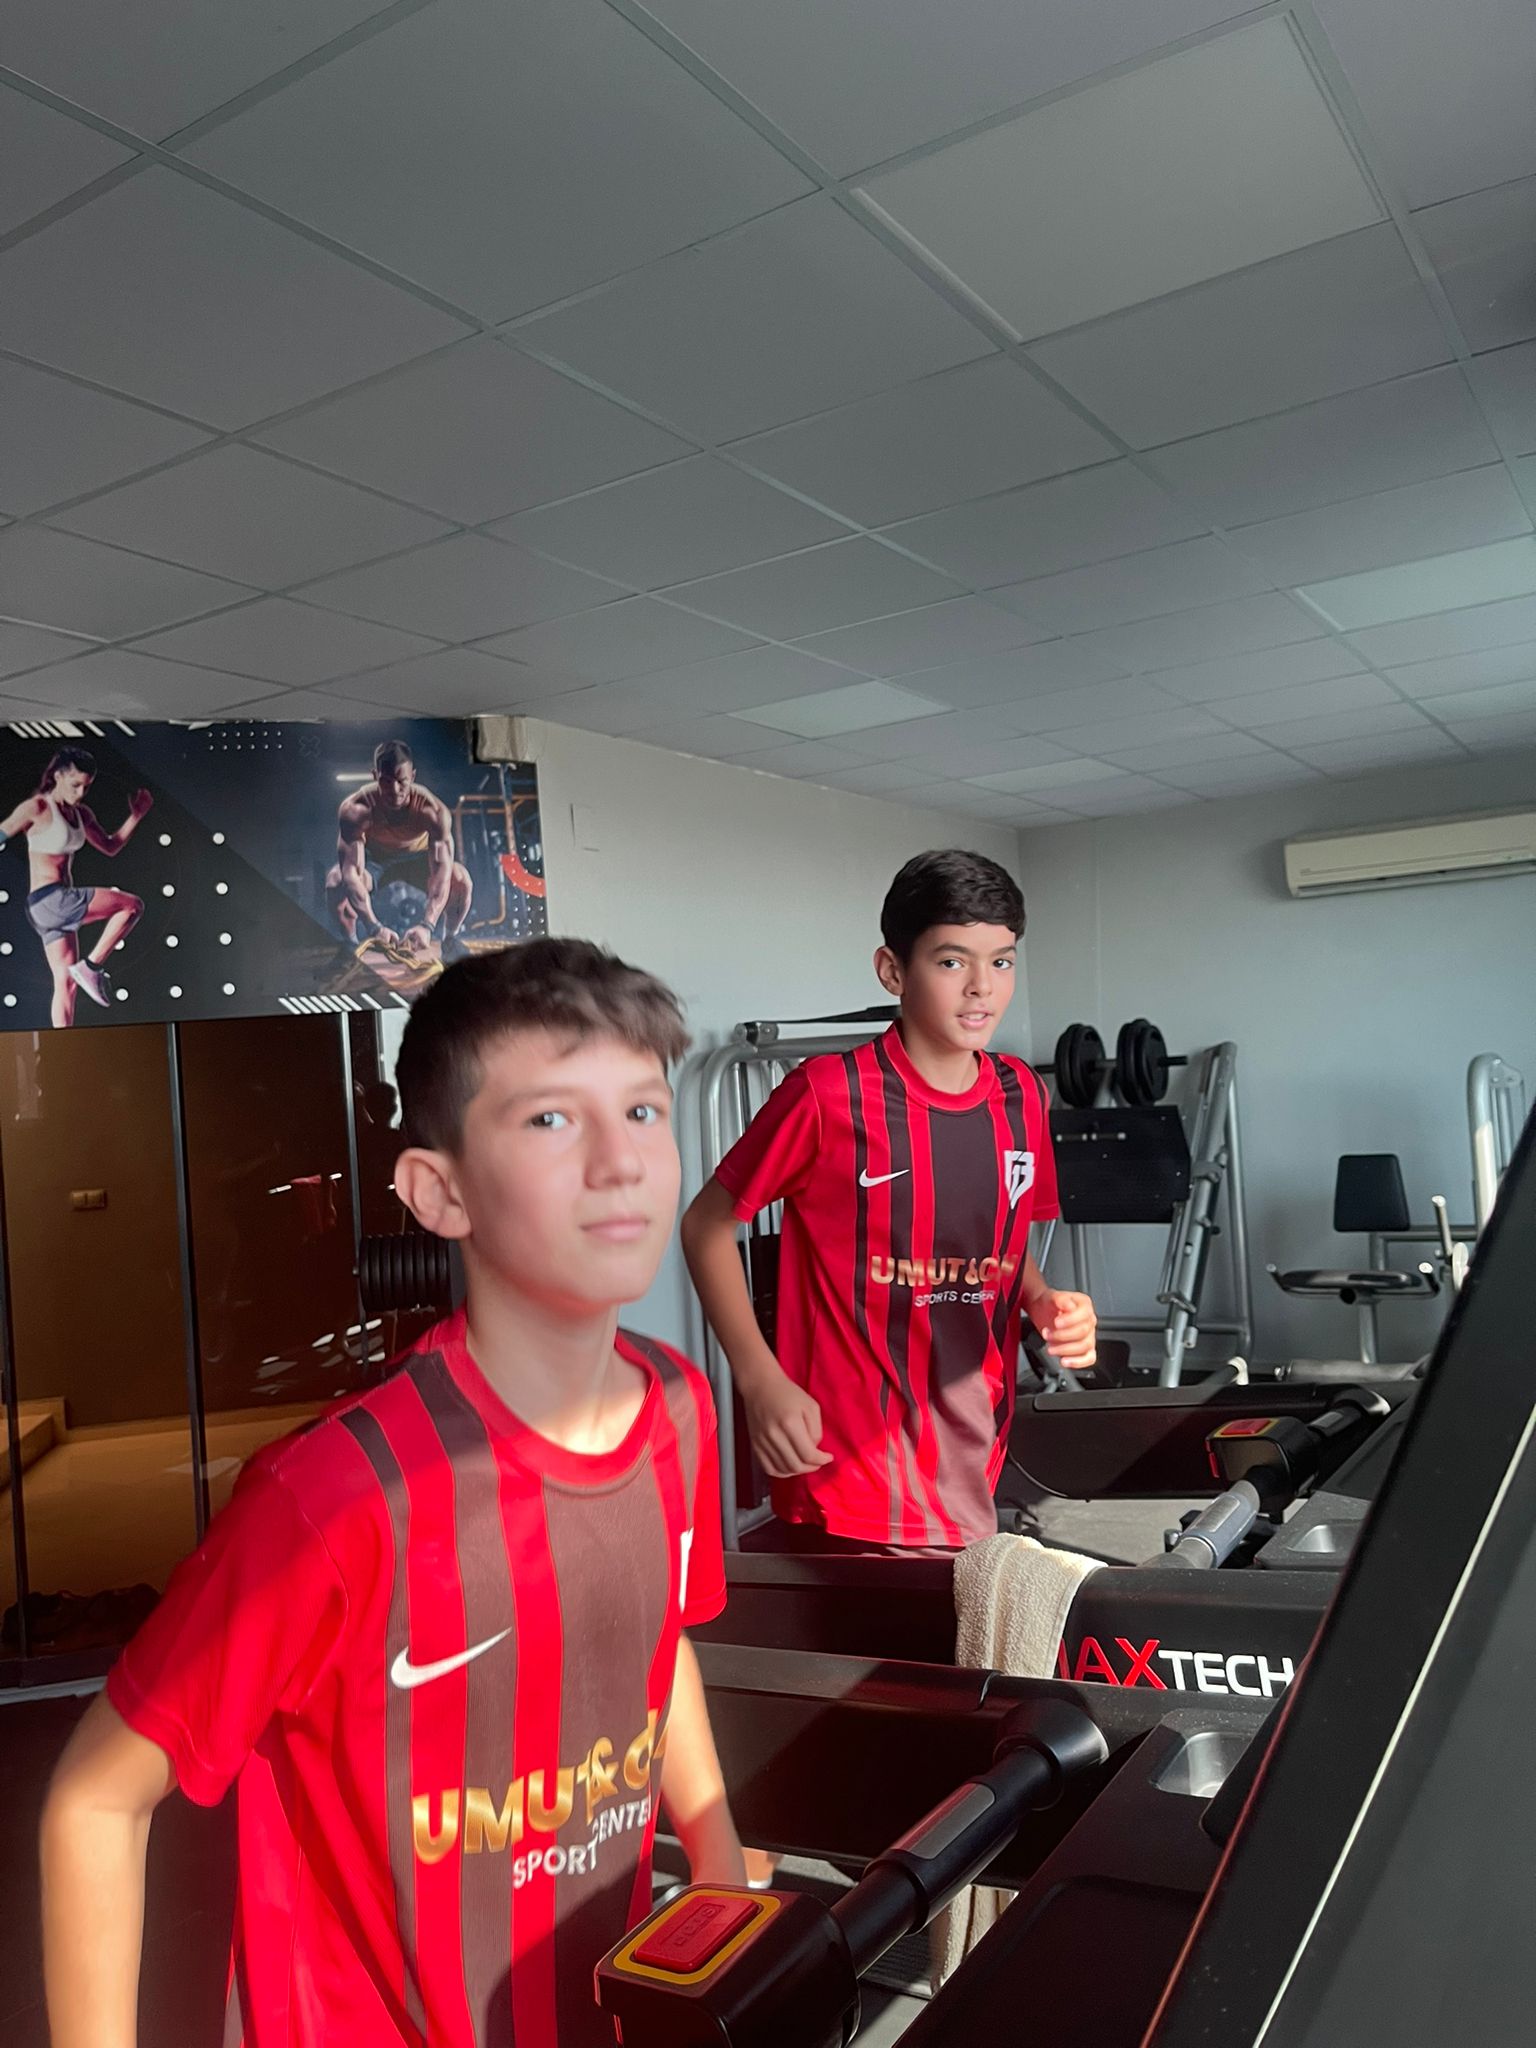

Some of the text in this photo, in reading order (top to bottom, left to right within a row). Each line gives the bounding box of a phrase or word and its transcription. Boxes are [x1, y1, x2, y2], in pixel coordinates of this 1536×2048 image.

[914, 1290, 957, 1308] SPORTS
[1057, 1637, 1296, 1698] AXTECH
[592, 1795, 652, 1844] CENTE
